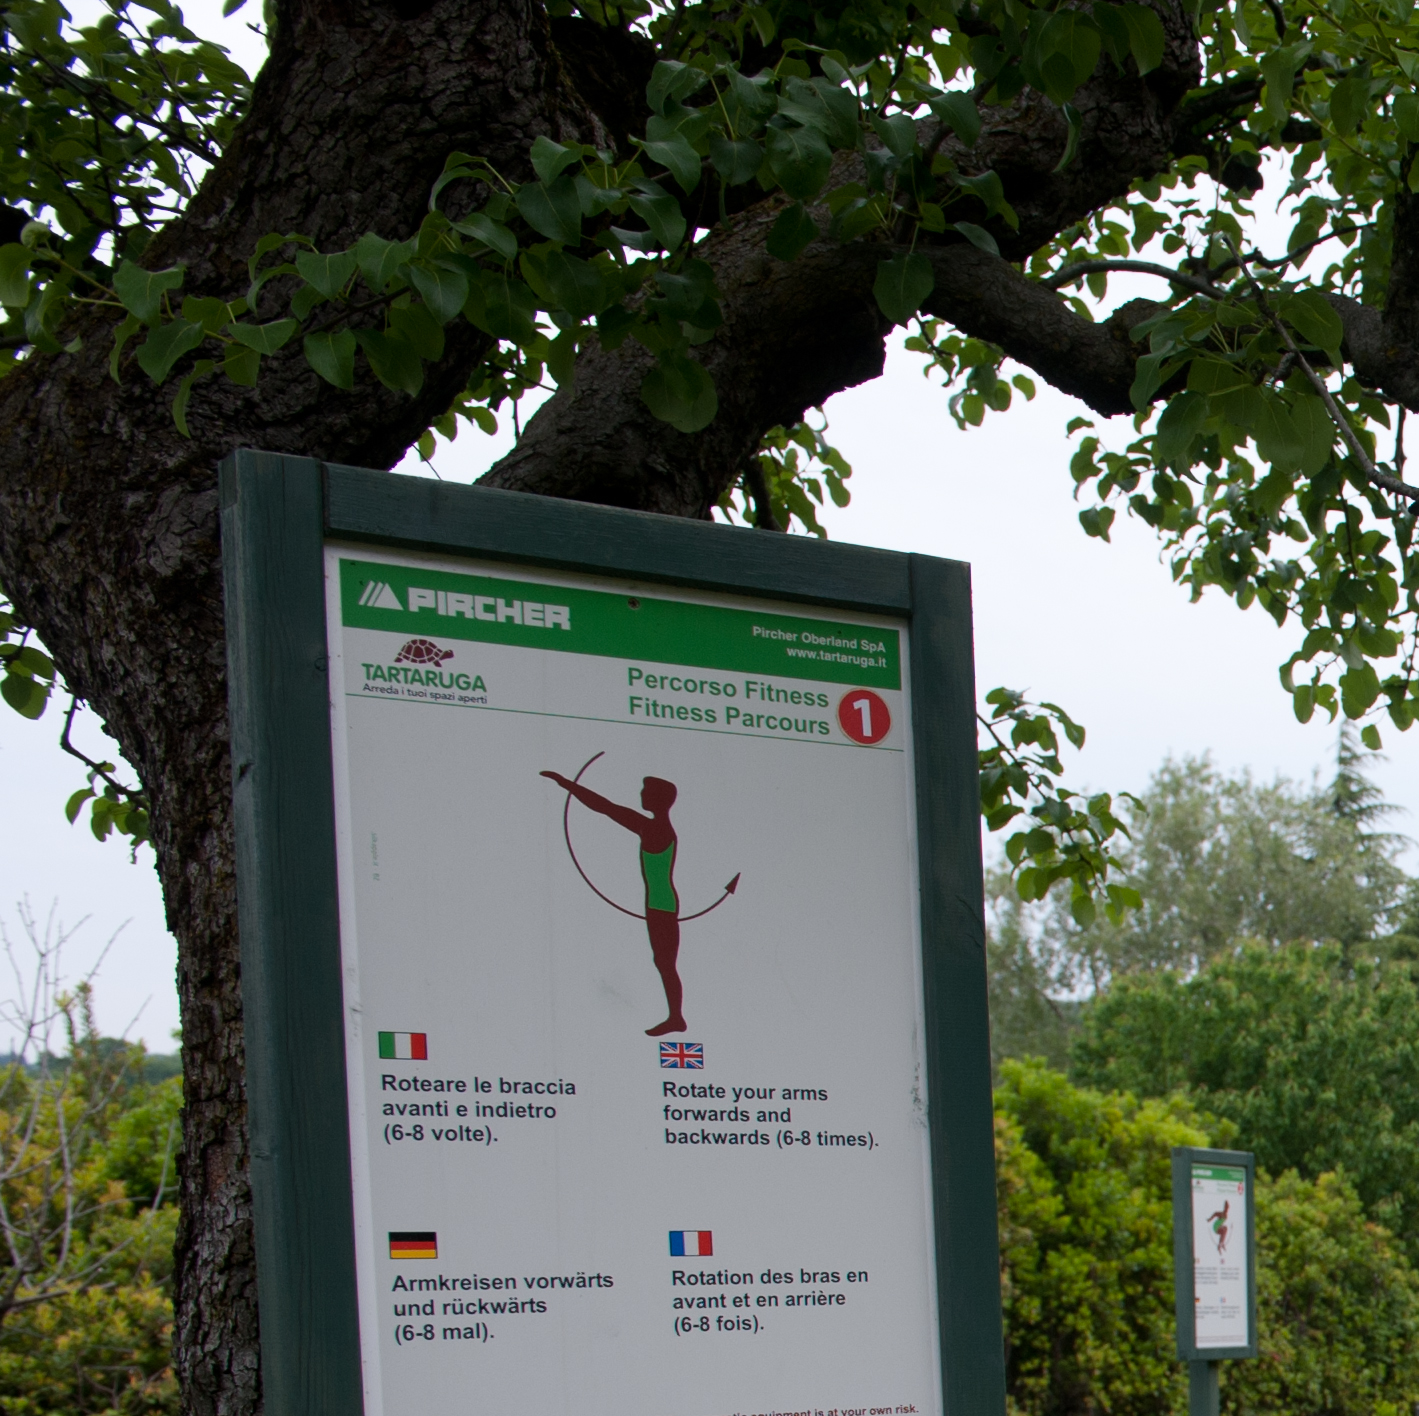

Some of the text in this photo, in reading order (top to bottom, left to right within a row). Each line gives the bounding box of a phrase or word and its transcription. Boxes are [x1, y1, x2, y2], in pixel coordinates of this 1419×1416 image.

[407, 586, 571, 631] PIRCHER
[752, 625, 886, 654] Pircher Oberland SpA
[786, 646, 887, 669] www.tartaruga.it
[361, 663, 487, 693] TARTARUGA
[627, 666, 829, 708] Percorso Fitness
[362, 683, 399, 696] Arreda
[407, 688, 427, 699] tuoi
[430, 690, 455, 703] spazi
[457, 692, 488, 705] aperti
[629, 695, 830, 735] Fitness Parcours
[852, 698, 873, 738] 1
[381, 1074, 577, 1096] Roteare le braccia
[662, 1081, 828, 1103] Rotate your arms
[382, 1100, 557, 1119] avanti e indietro
[663, 1105, 792, 1123] forwards and
[384, 1123, 499, 1146] (6-8 volte).
[665, 1128, 879, 1150] backwards (6-8 times).
[391, 1271, 614, 1292] Armkreisen vorwärts
[672, 1268, 869, 1286] Rotation des bras en
[393, 1297, 547, 1317] und rückwärts
[673, 1290, 846, 1310] avant et en arrière
[394, 1322, 494, 1346] (6-8 mal).
[674, 1315, 764, 1337] (6-8 fois).
[869, 1405, 893, 1416] own
[895, 1403, 919, 1415] risk.
